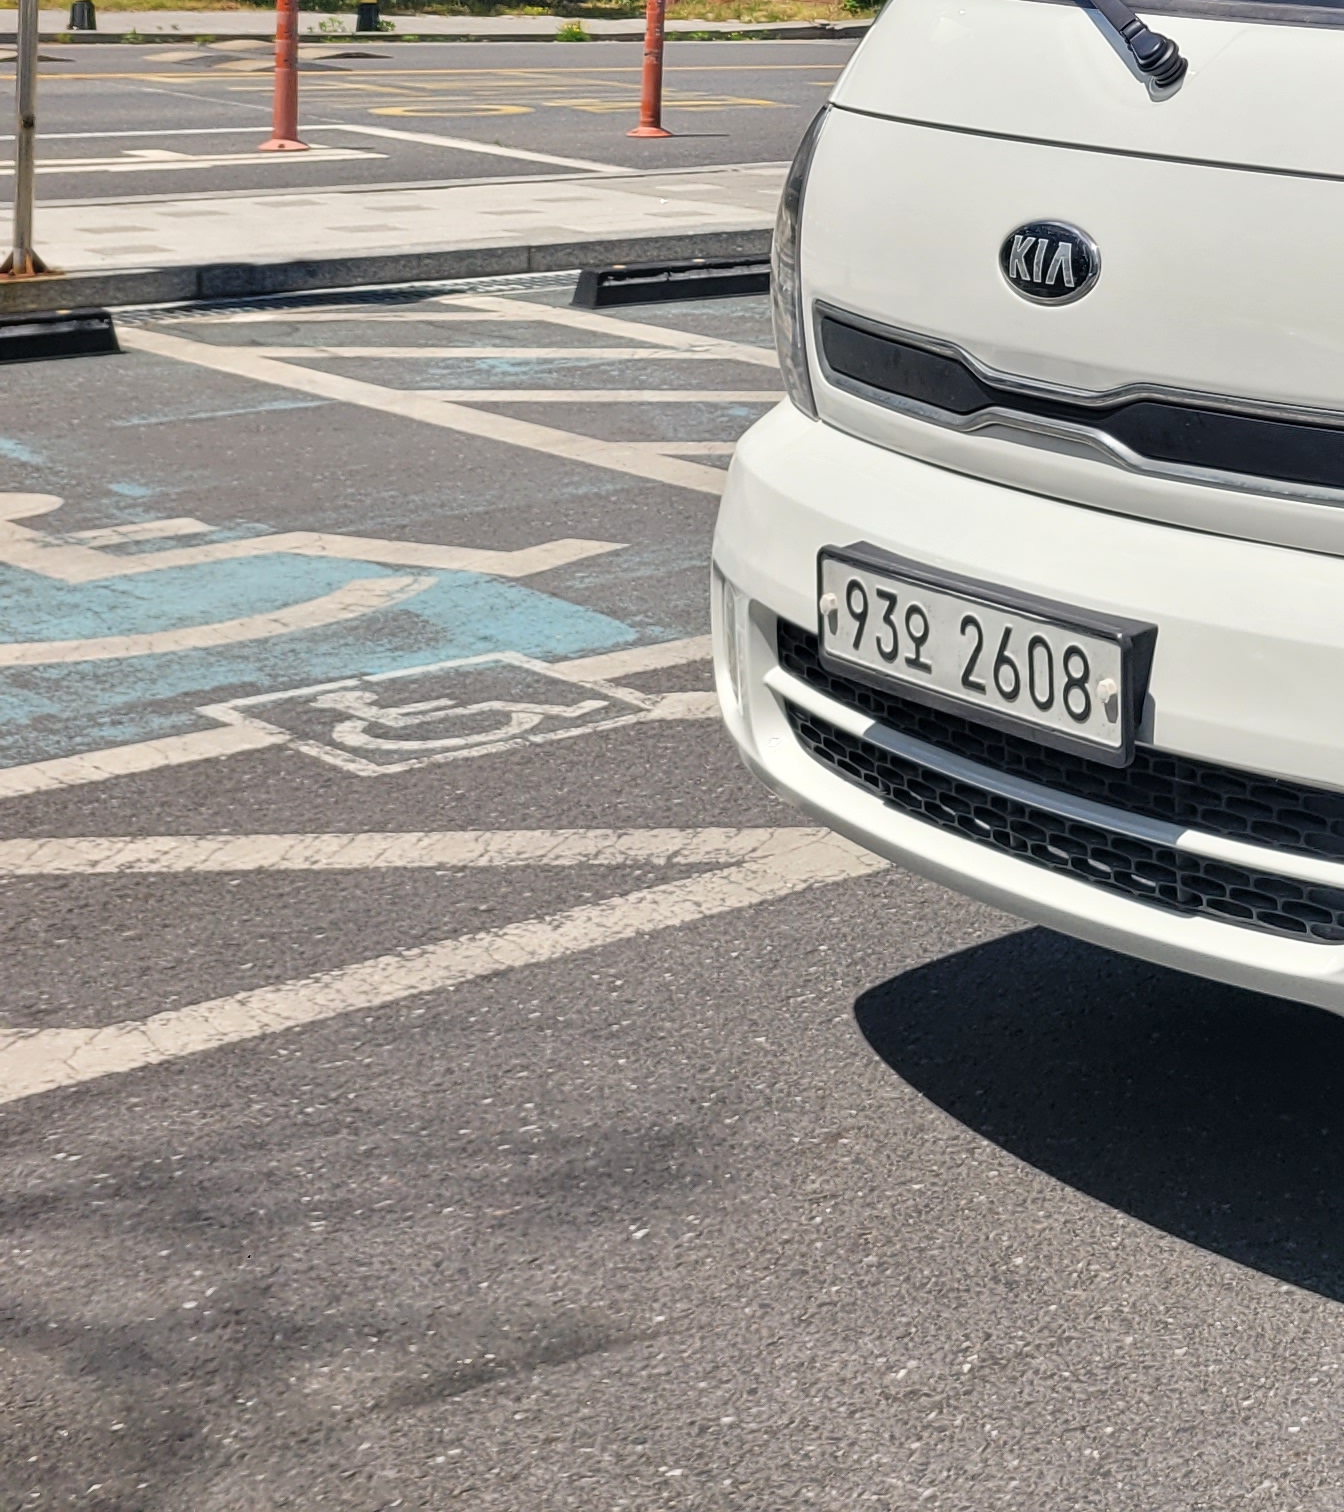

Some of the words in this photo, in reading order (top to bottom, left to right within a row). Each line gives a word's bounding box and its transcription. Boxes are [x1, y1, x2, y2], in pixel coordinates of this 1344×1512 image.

[1009, 234, 1075, 288] KIA
[846, 578, 932, 675] 93오
[960, 614, 1091, 722] 2608
